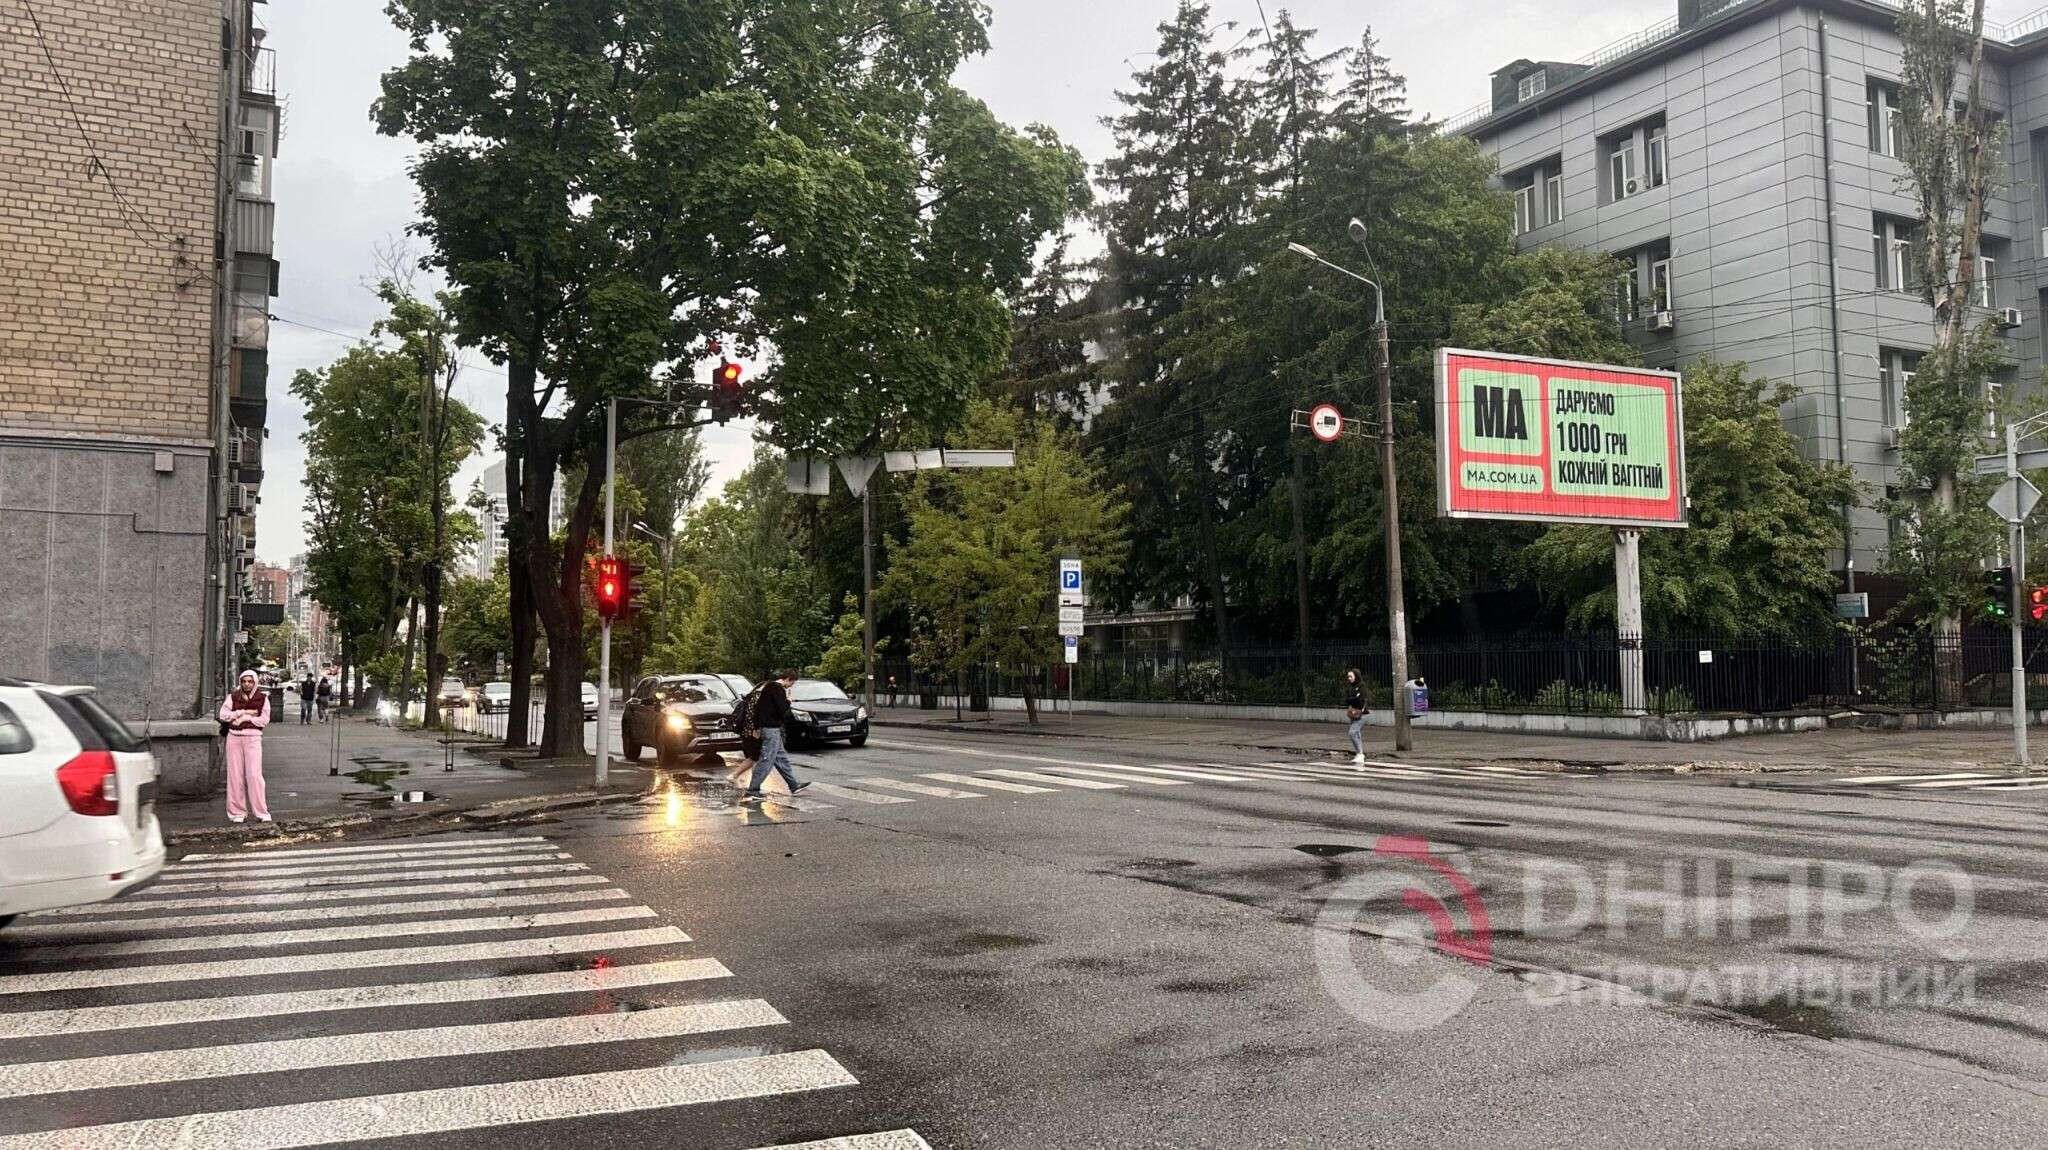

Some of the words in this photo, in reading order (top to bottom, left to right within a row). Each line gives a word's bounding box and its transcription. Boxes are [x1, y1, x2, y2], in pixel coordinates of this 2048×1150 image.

[1473, 385, 1528, 440] MA
[1556, 389, 1615, 416] ДАРУЄМО
[1557, 421, 1601, 453] 1000
[1605, 432, 1627, 455] ГРН
[1467, 470, 1537, 485] MA.COM.UA
[1559, 459, 1608, 485] КОЖНІЙ
[1612, 463, 1663, 489] ВАГІТНІЙ
[601, 564, 617, 574] 41
[1067, 572, 1075, 586] P
